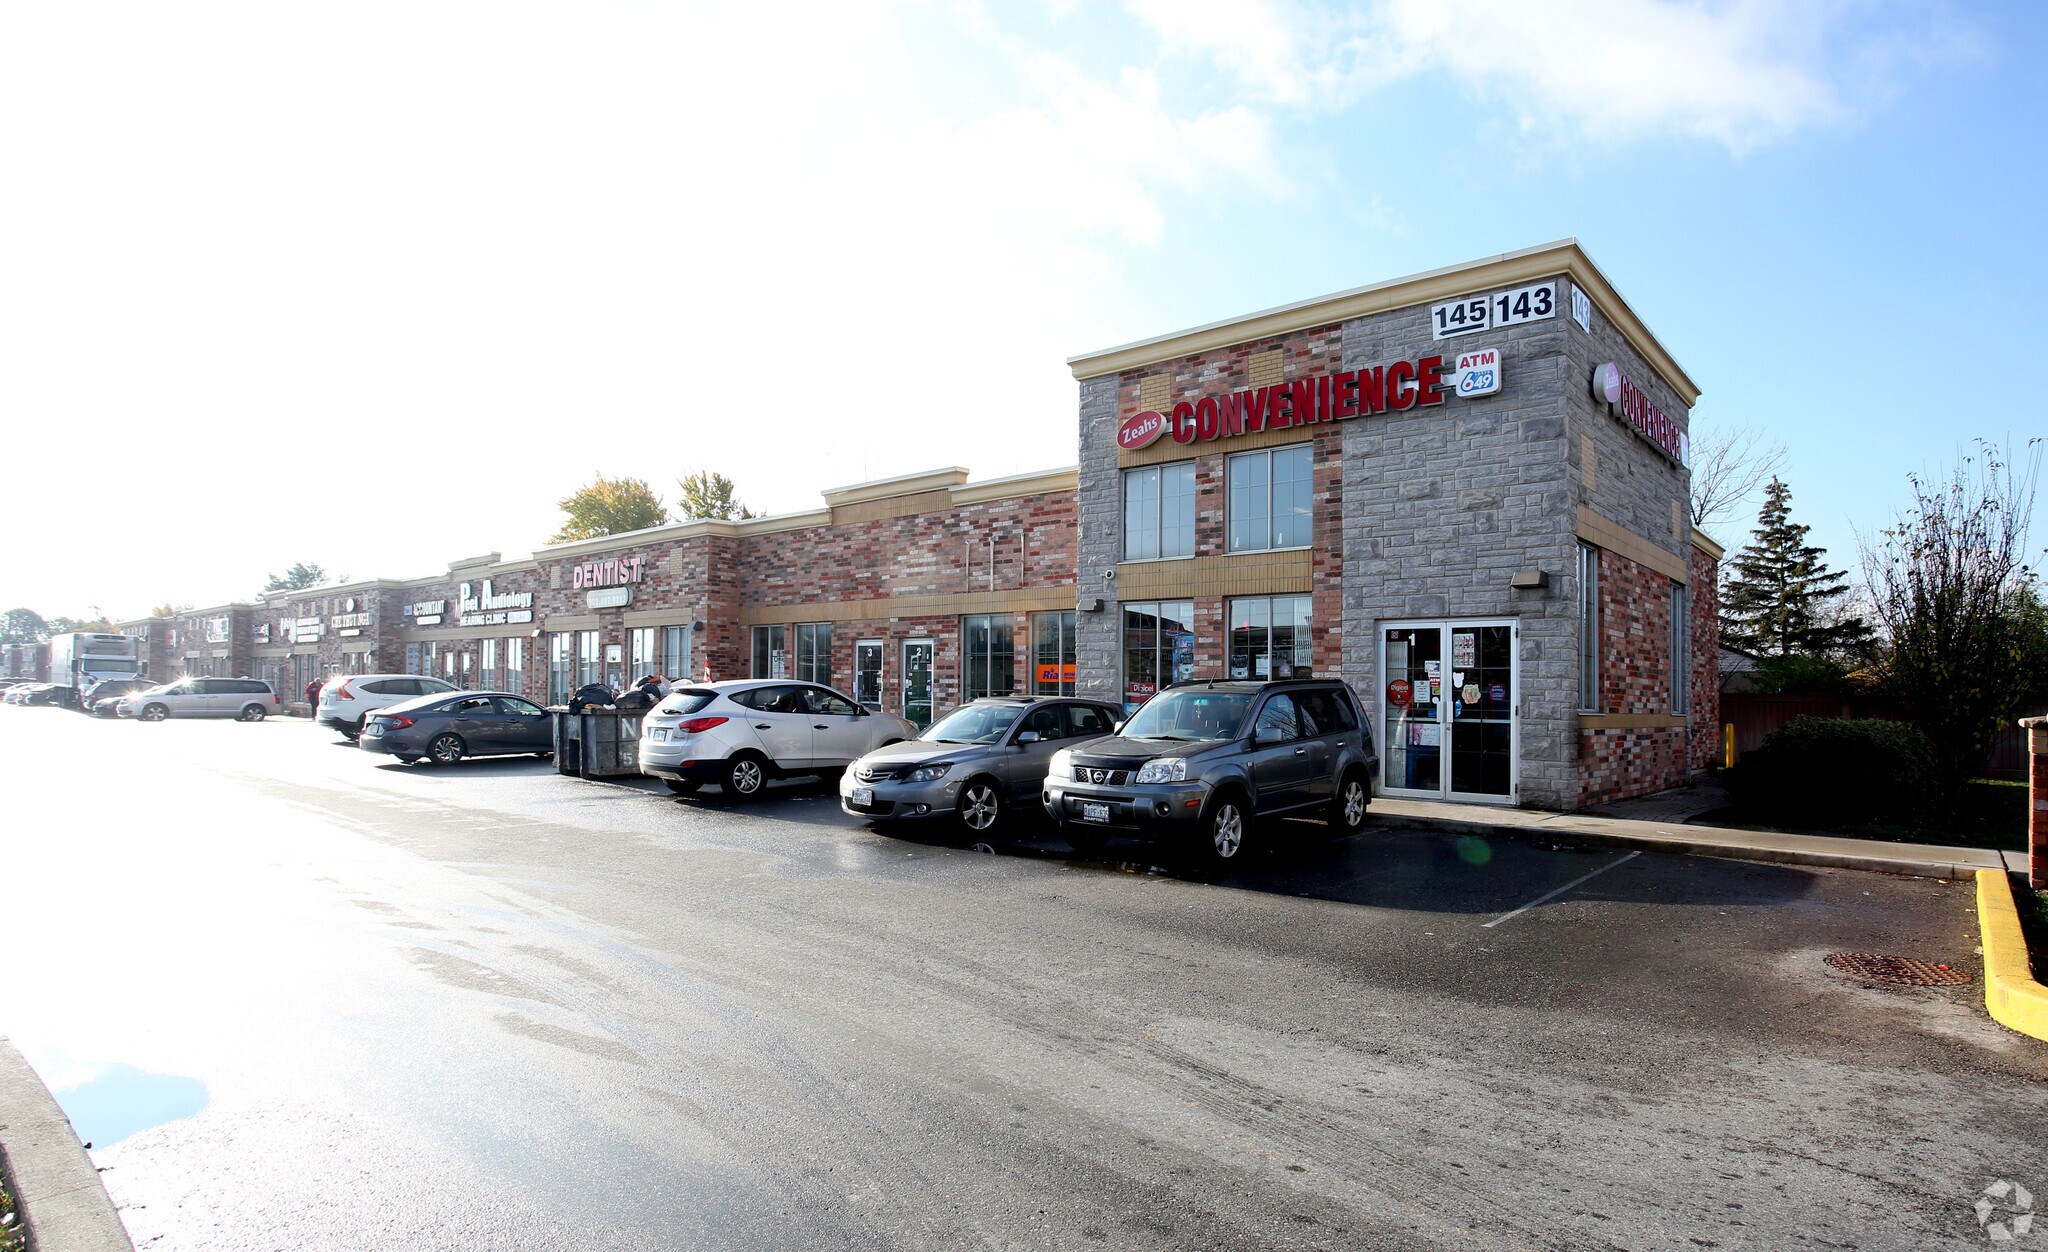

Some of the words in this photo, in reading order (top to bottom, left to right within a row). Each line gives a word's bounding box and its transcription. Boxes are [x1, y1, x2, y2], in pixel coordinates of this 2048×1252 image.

[1434, 300, 1487, 329] 145
[1496, 287, 1552, 323] 143
[1572, 289, 1589, 330] 143
[1459, 352, 1494, 369] ATM
[1172, 355, 1445, 445] CONVENIENCE
[1621, 375, 1680, 461] CONVENIENCE
[1121, 416, 1159, 446] Zeahs
[573, 557, 642, 589] DENTIST
[460, 582, 478, 612] Peel
[481, 580, 533, 610] Audiology
[413, 600, 445, 616] ACCOUNTANT
[460, 615, 485, 626] HEARING
[486, 613, 506, 624] CLINIC
[1408, 633, 1416, 646] 1
[867, 648, 873, 657] 3
[916, 647, 922, 656] 2
[1043, 669, 1059, 680] Ria
[1390, 684, 1409, 692] Digicel
[621, 718, 637, 739] N
